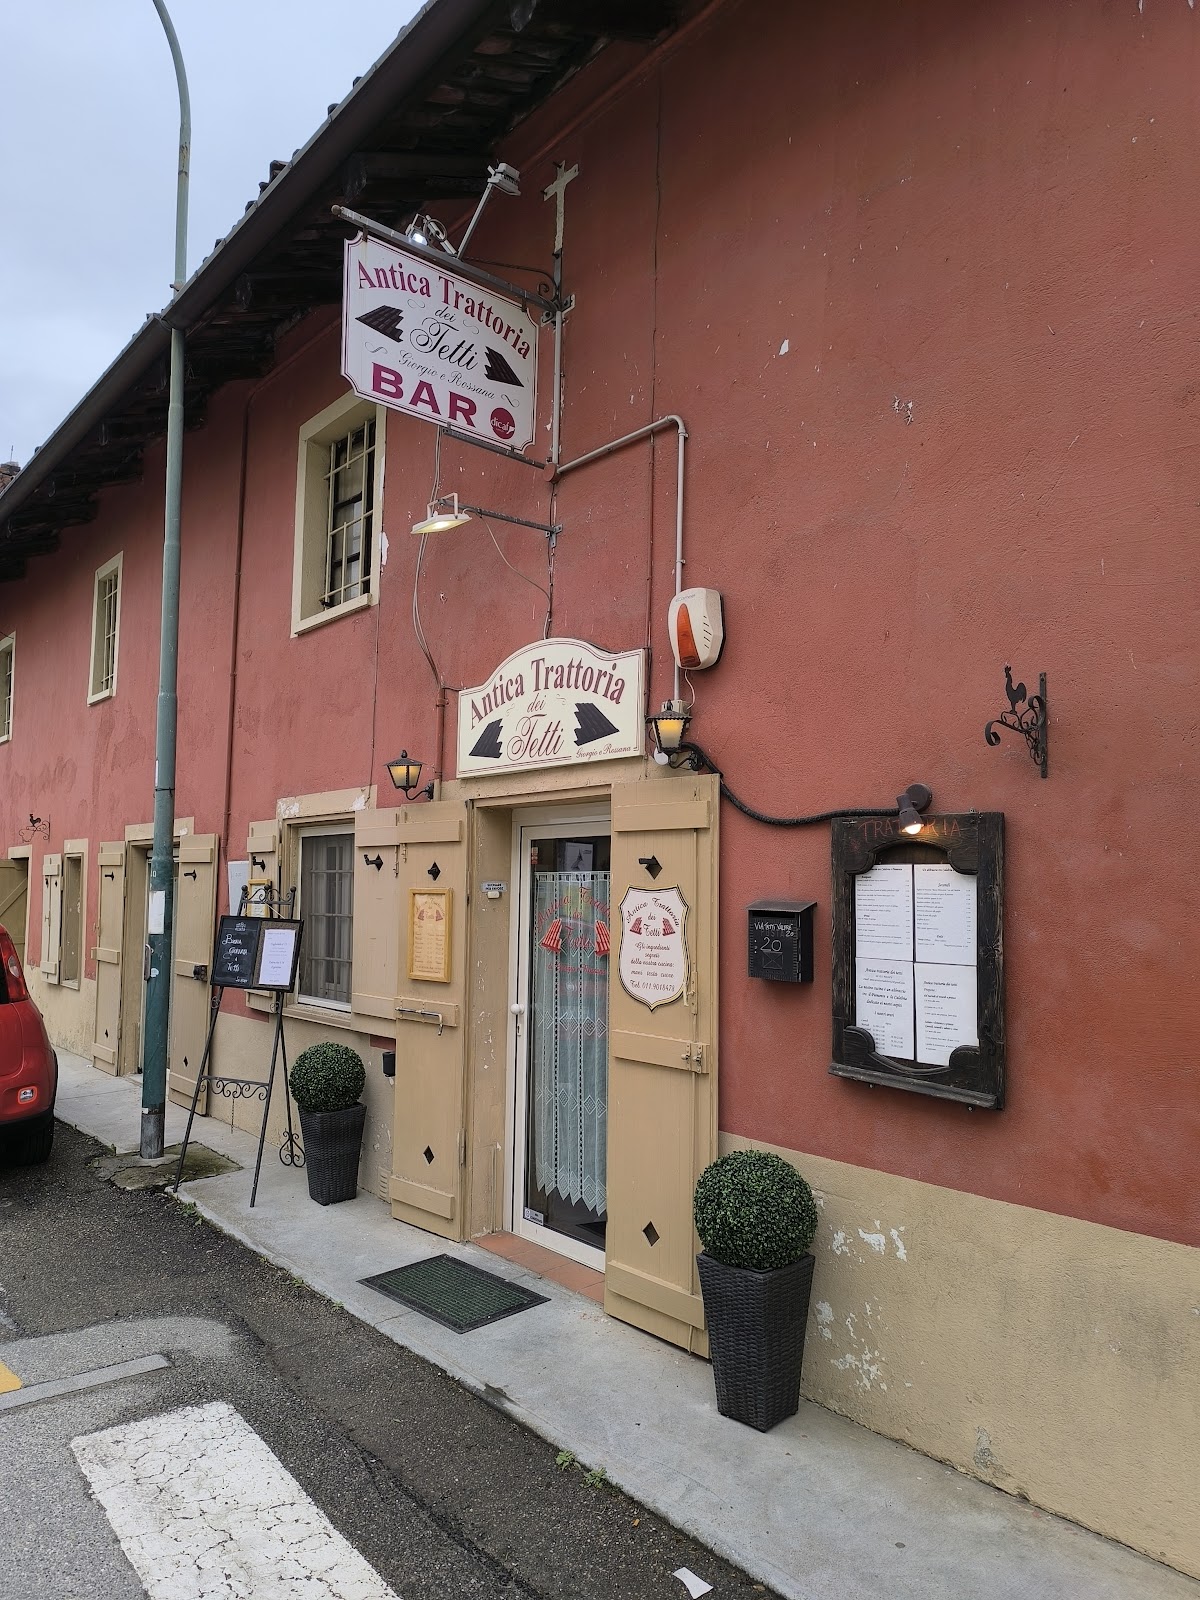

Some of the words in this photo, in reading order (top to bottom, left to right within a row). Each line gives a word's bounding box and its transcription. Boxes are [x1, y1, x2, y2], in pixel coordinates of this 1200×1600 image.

[358, 259, 431, 297] Antica
[438, 276, 531, 360] Trattoria
[434, 306, 455, 323] dei
[409, 317, 479, 371] Tetti
[398, 349, 438, 377] Giorgio
[447, 372, 496, 400] Rossana
[371, 361, 478, 429] BAR
[469, 672, 525, 730] Antica
[530, 657, 626, 705] Trattoria
[526, 692, 547, 713] dei
[506, 713, 565, 762] Tetti
[576, 745, 598, 759] Giorgio
[602, 743, 631, 755] Rossana
[626, 902, 649, 924] Antica
[651, 897, 680, 928] Trattoria
[647, 912, 656, 921] dei
[642, 923, 662, 937] Tetti
[760, 936, 782, 952] 20
